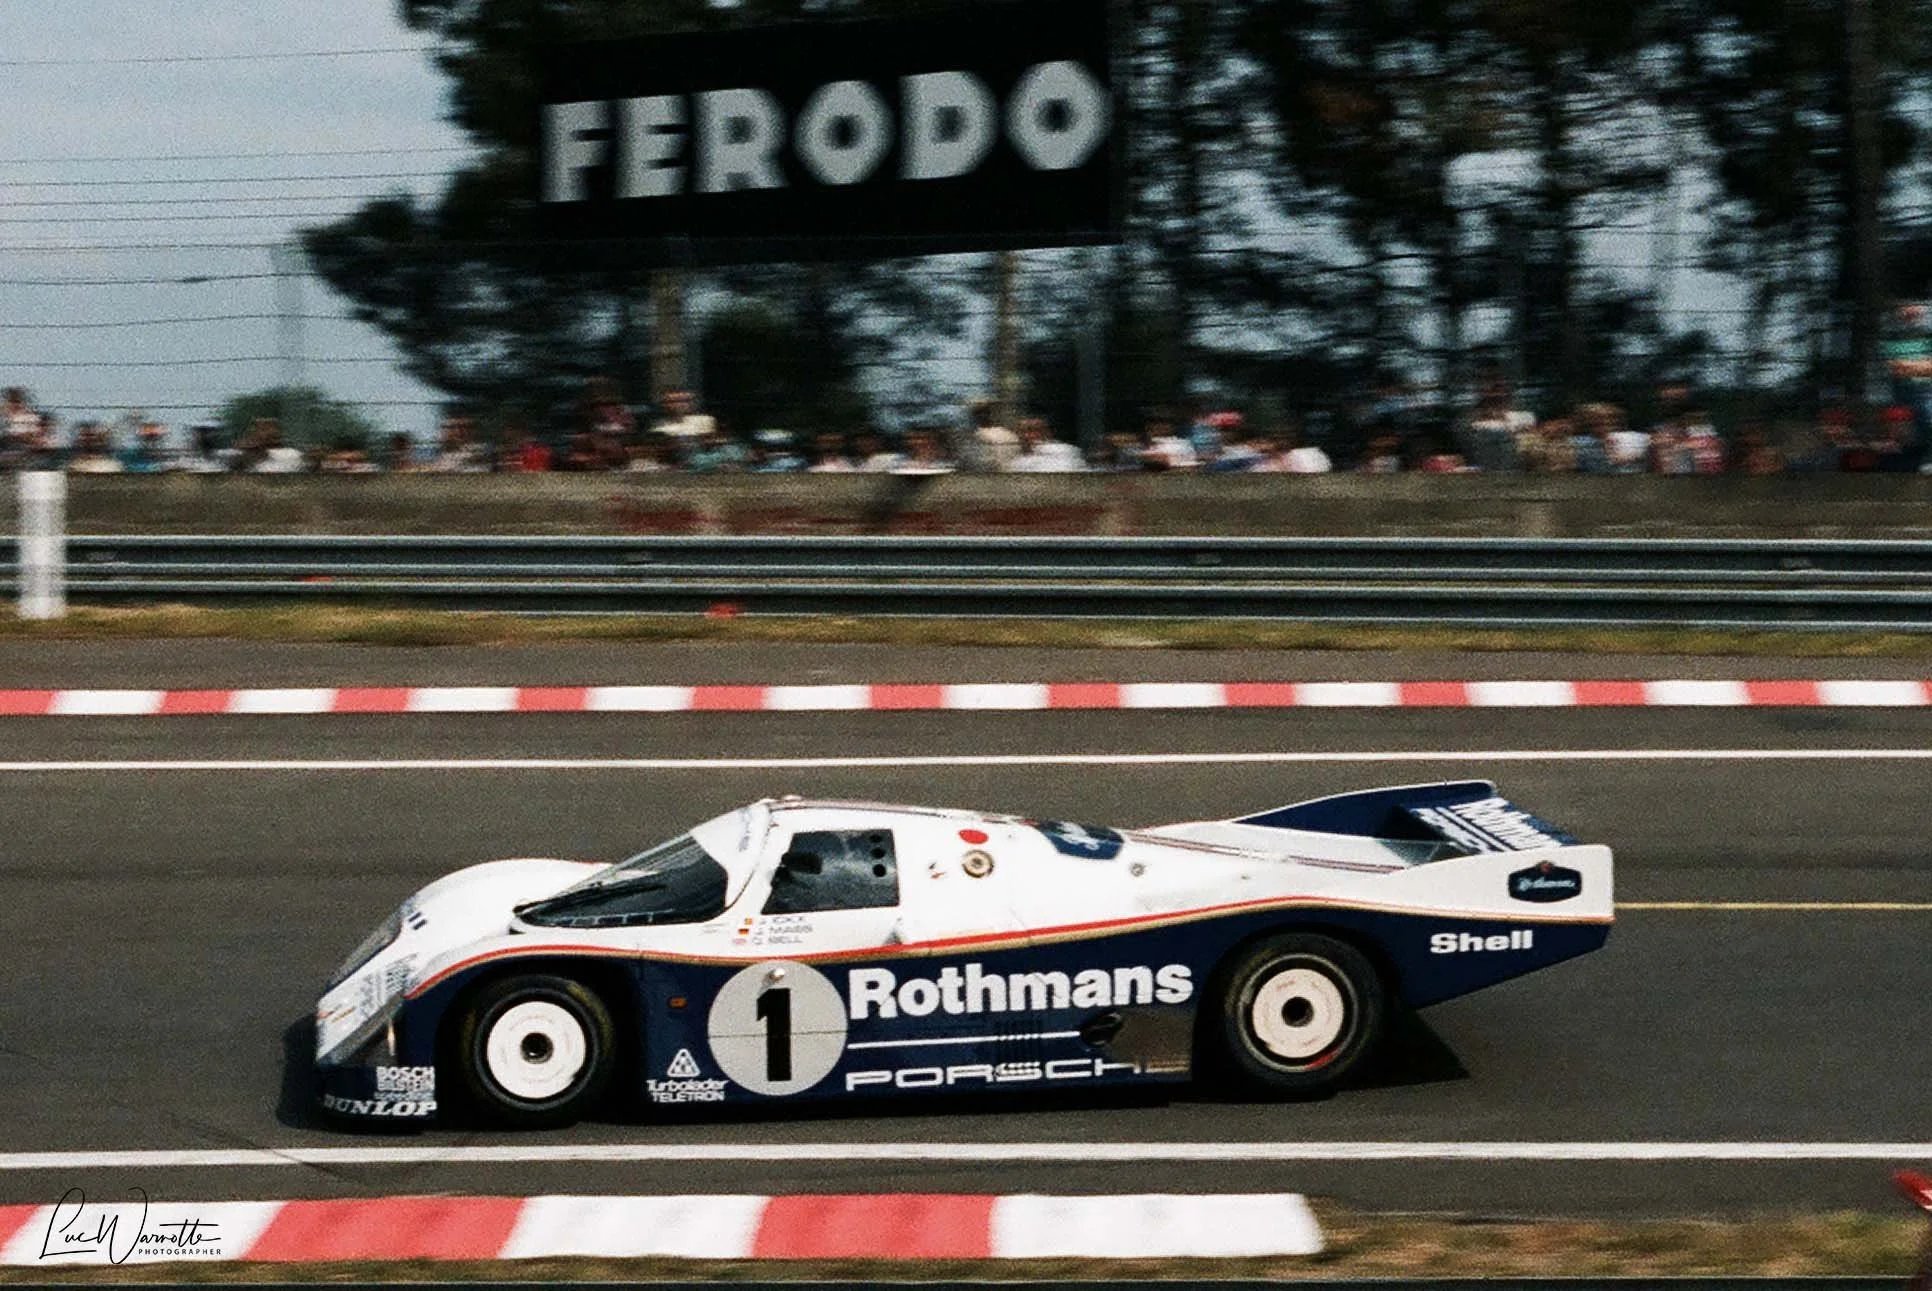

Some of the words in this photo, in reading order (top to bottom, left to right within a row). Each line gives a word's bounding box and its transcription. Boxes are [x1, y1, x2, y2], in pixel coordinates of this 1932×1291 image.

[540, 60, 1112, 202] FERODO
[1430, 930, 1533, 954] Shell
[849, 963, 1194, 1020] Rothmans
[756, 988, 792, 1082] 1
[376, 1066, 435, 1081] BOSCH
[846, 1057, 1190, 1091] PORSCHE
[323, 1093, 438, 1117] DUNLOP
